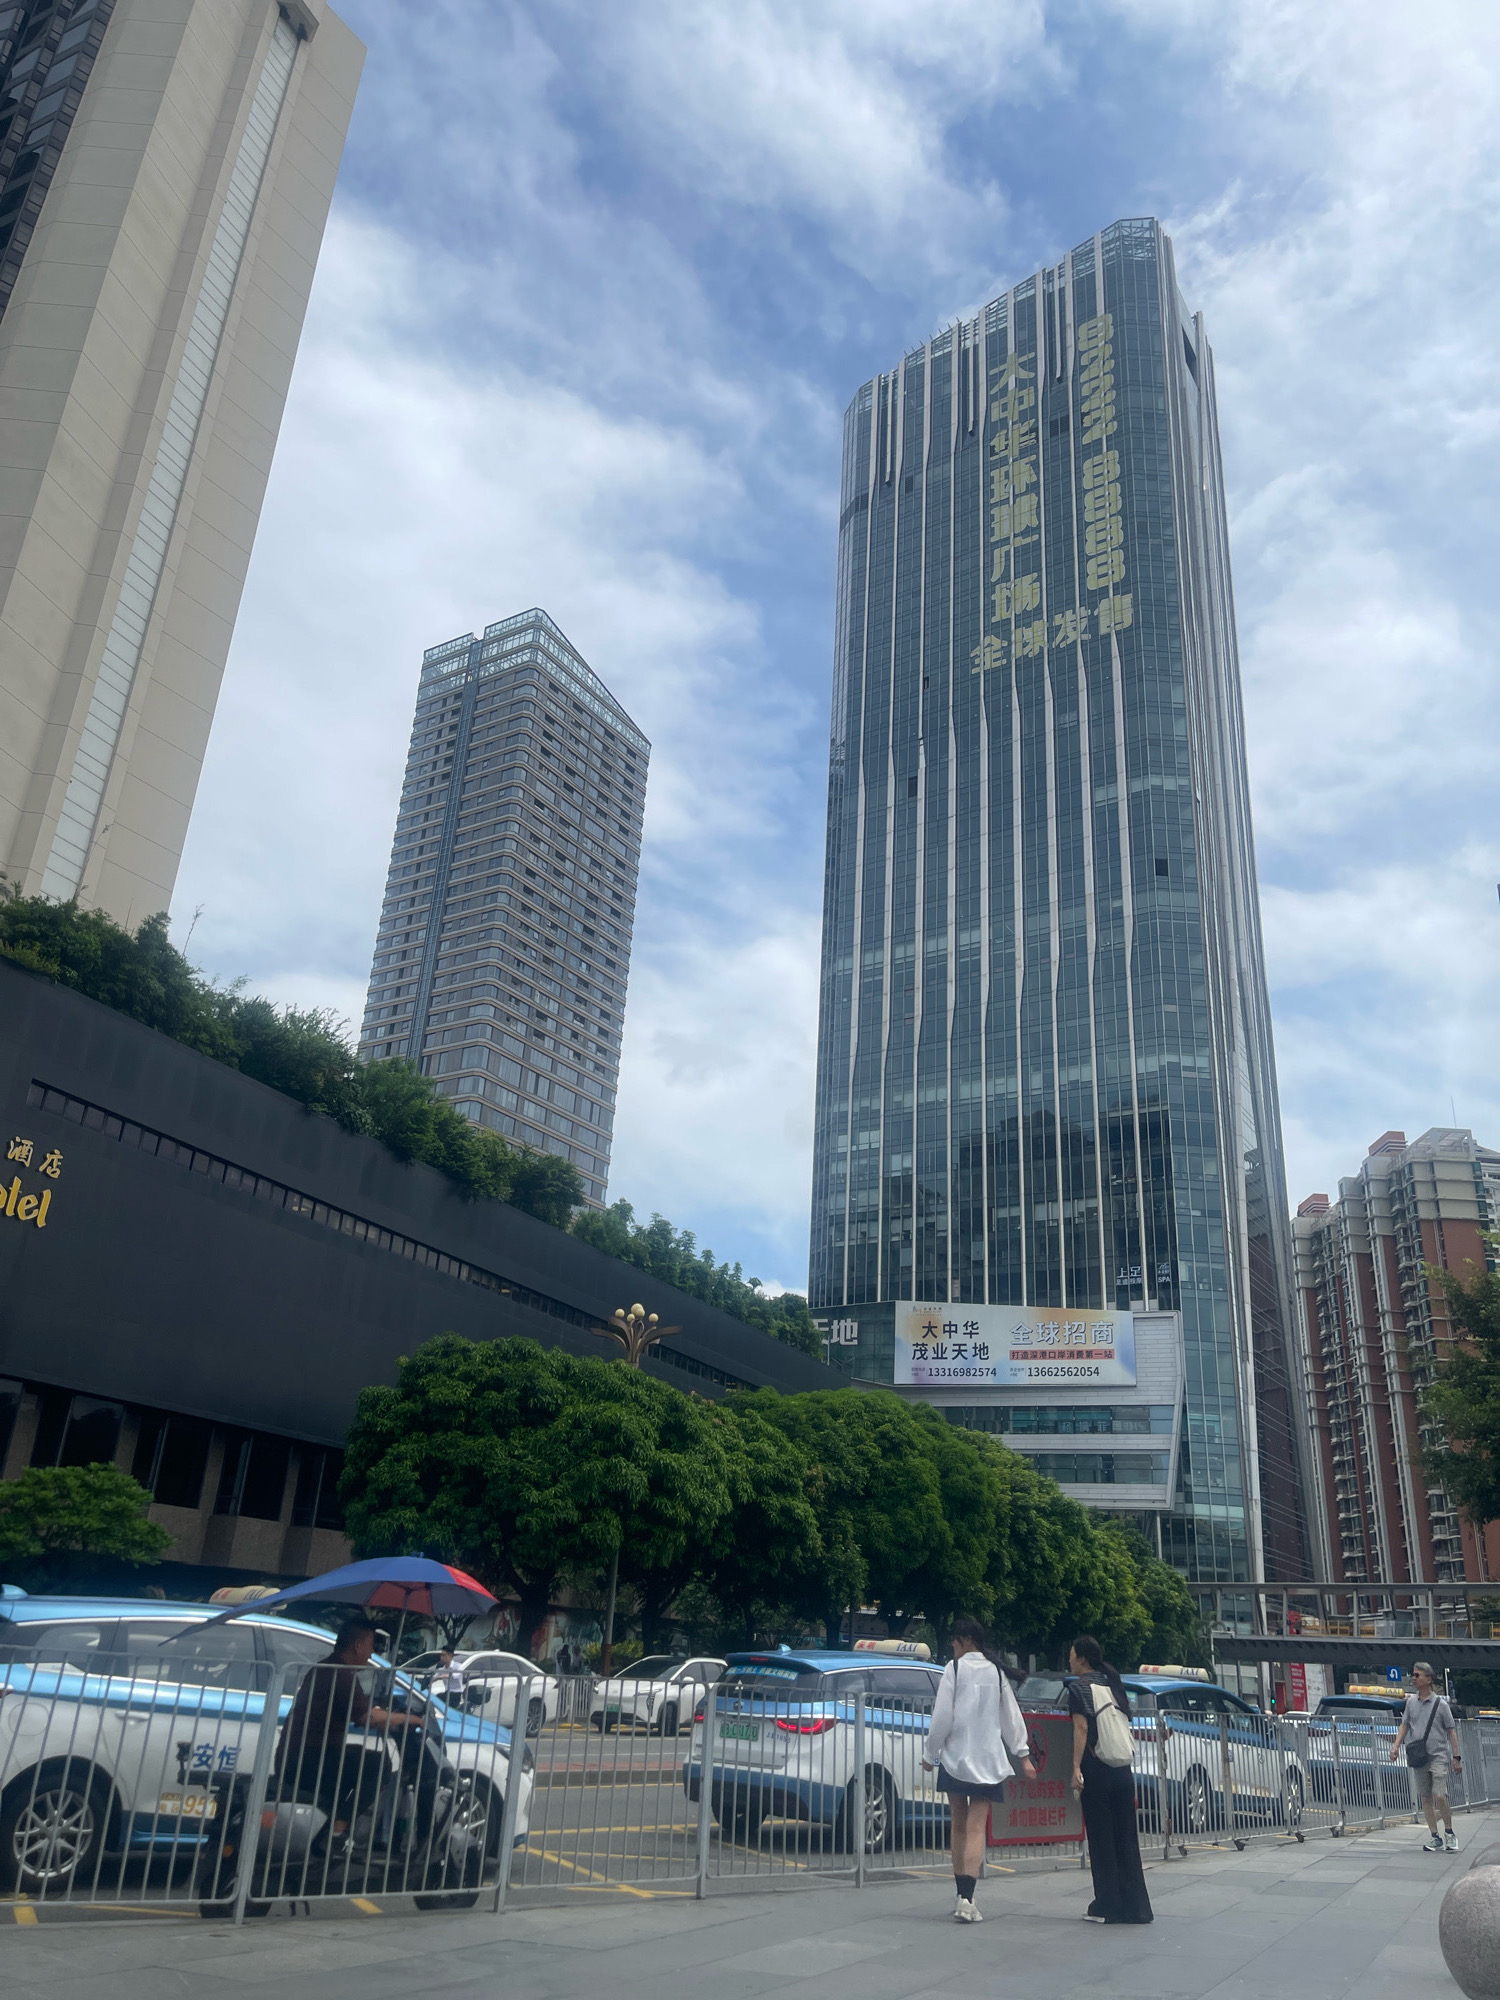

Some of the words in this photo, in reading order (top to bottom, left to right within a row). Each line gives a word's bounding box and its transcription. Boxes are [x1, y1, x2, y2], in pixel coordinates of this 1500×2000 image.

[990, 352, 1041, 623] 大中华环球广场
[1083, 450, 1126, 590] 8888
[970, 593, 1134, 674] 全球发售
[8, 1136, 64, 1178] 酒店
[922, 1320, 980, 1339] 大中华
[1010, 1320, 1114, 1346] 全球招商
[912, 1342, 990, 1361] 茂业天地
[1011, 1350, 1113, 1360] 打造深港口岸消费第一站
[928, 1367, 997, 1377] 13316982574
[1027, 1366, 1100, 1377] 13662562054
[896, 1643, 918, 1652] TAXI
[1180, 1667, 1199, 1676] TAXI
[1008, 1780, 1067, 1800] 为了您的安全
[1008, 1806, 1067, 1828] 请勿翻越栏杆
